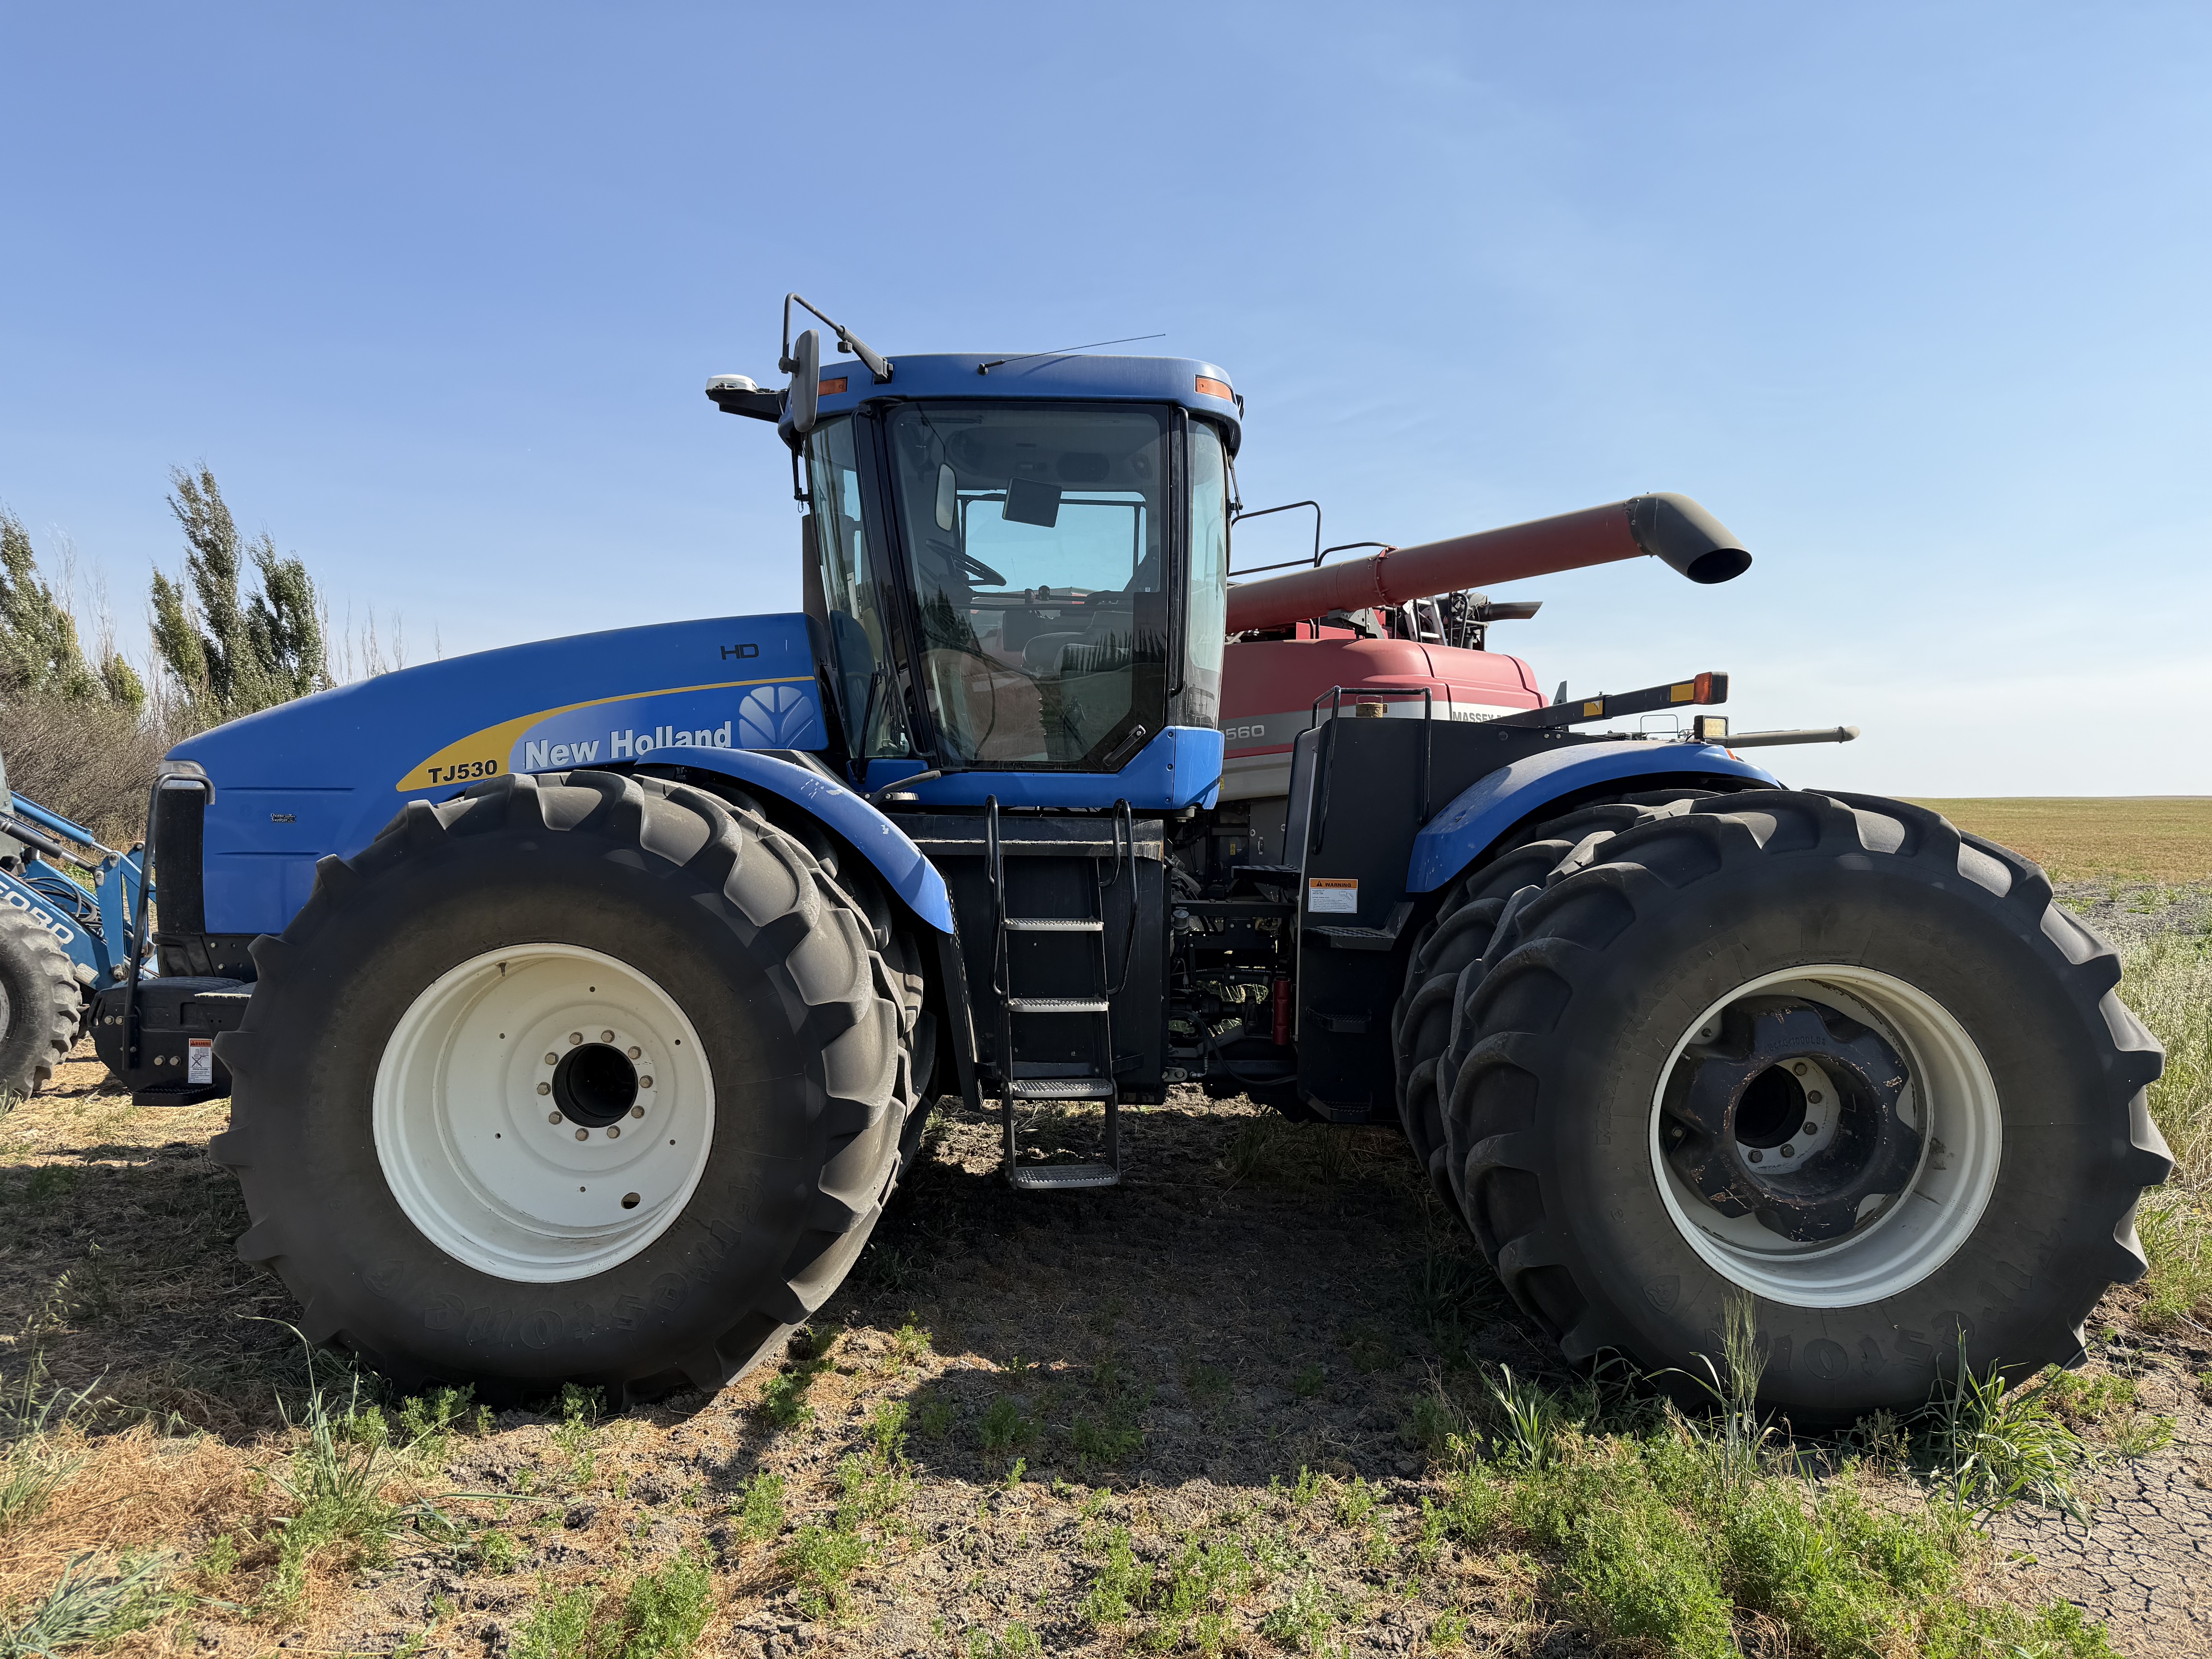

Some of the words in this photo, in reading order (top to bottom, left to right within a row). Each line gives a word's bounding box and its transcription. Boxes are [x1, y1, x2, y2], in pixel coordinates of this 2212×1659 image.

[721, 644, 759, 660] HD
[1220, 725, 1264, 740] 560
[525, 739, 599, 770] New
[610, 721, 732, 758] Holland
[428, 760, 497, 783] TJ530
